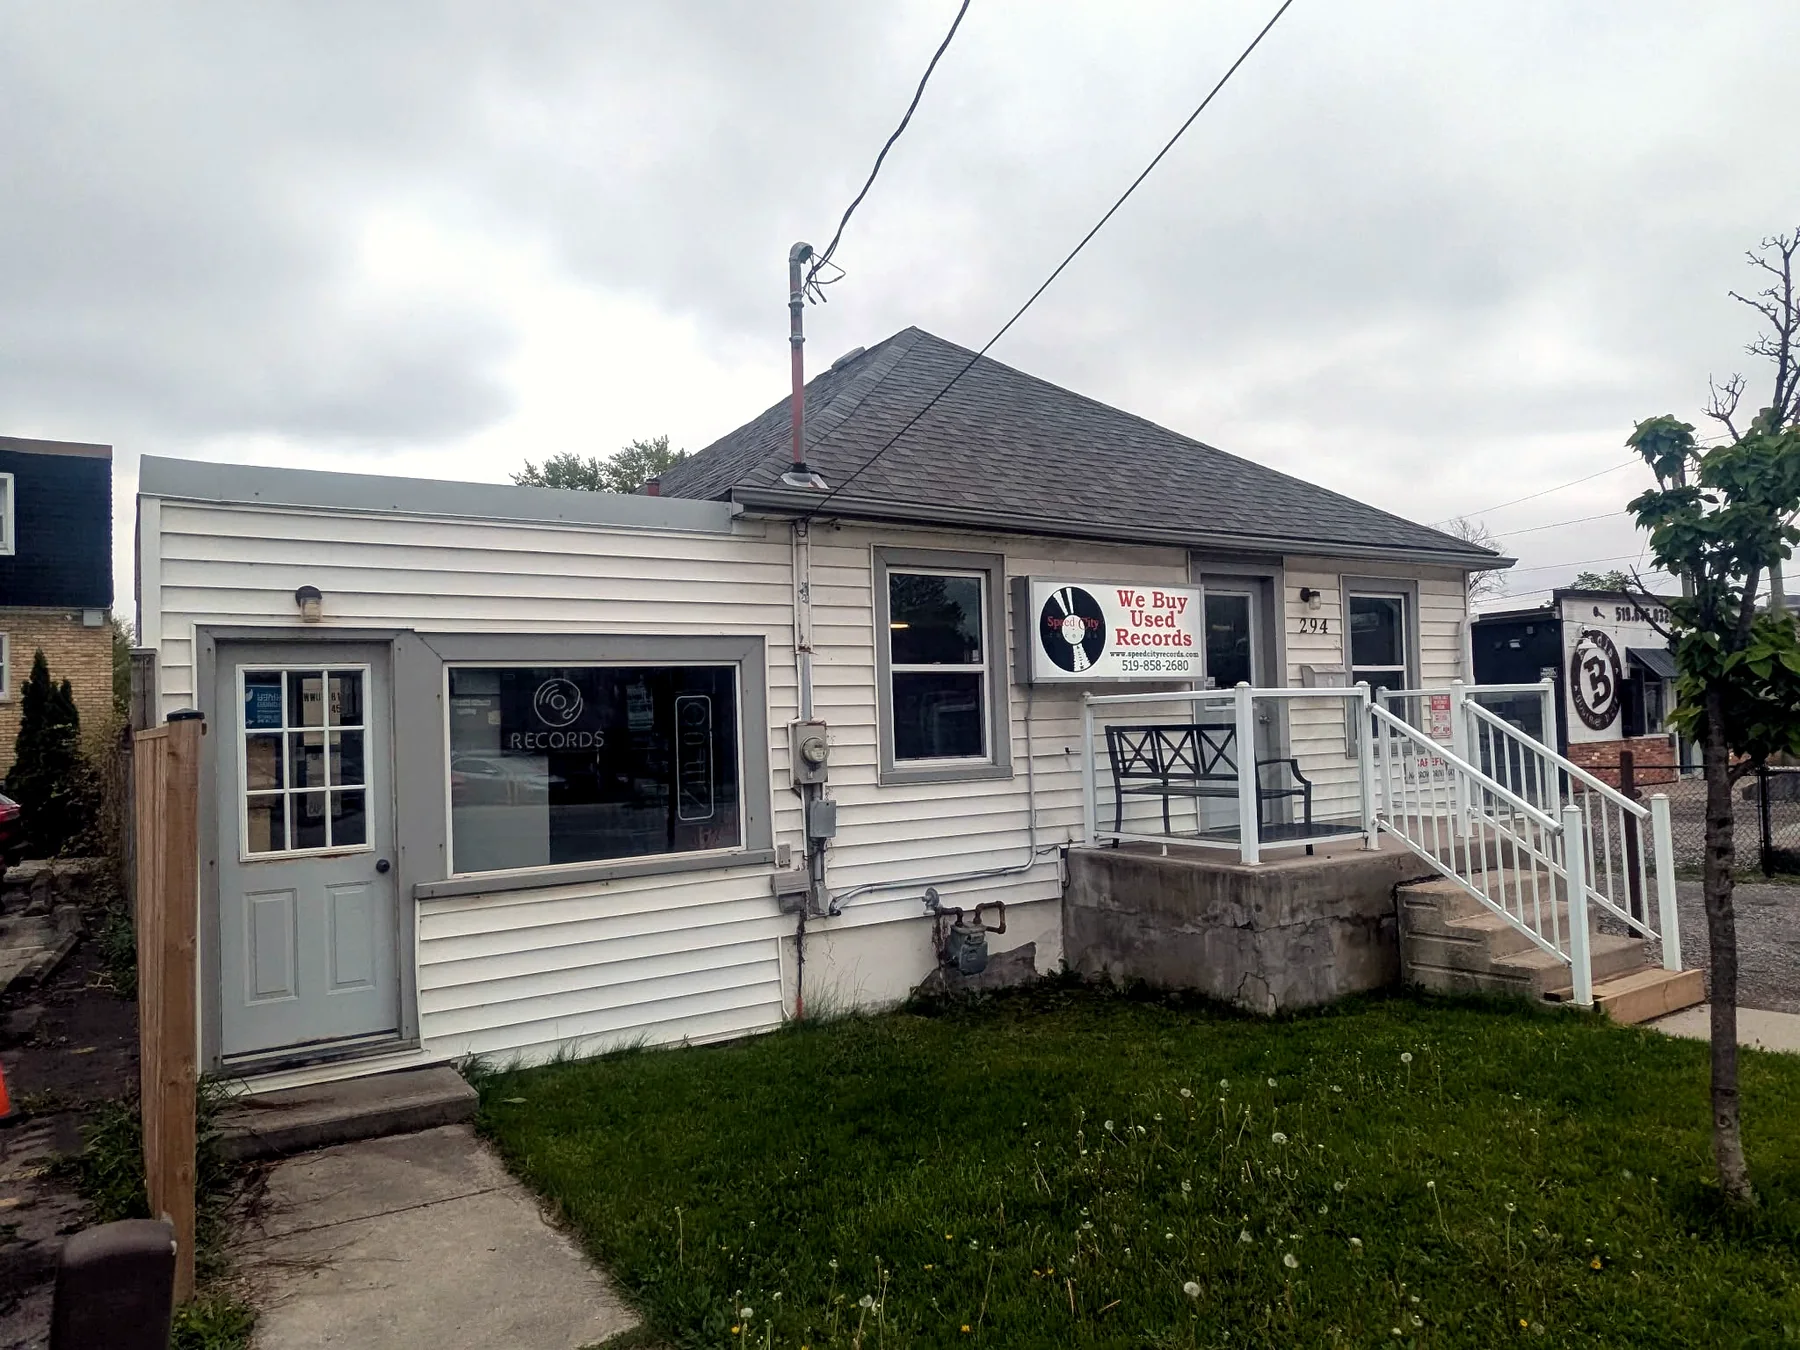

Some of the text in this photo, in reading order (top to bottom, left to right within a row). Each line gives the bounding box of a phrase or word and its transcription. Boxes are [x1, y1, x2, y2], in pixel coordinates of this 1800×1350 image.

[1117, 590, 1188, 614] We Buy
[1047, 616, 1099, 631] Speed City
[1130, 610, 1176, 628] Used
[1299, 617, 1329, 634] 294
[1115, 628, 1192, 646] Records
[1109, 650, 1199, 658] www.speedcityrecords.com
[1122, 660, 1189, 671] 519-858-2680
[511, 731, 605, 748] RECORDS
